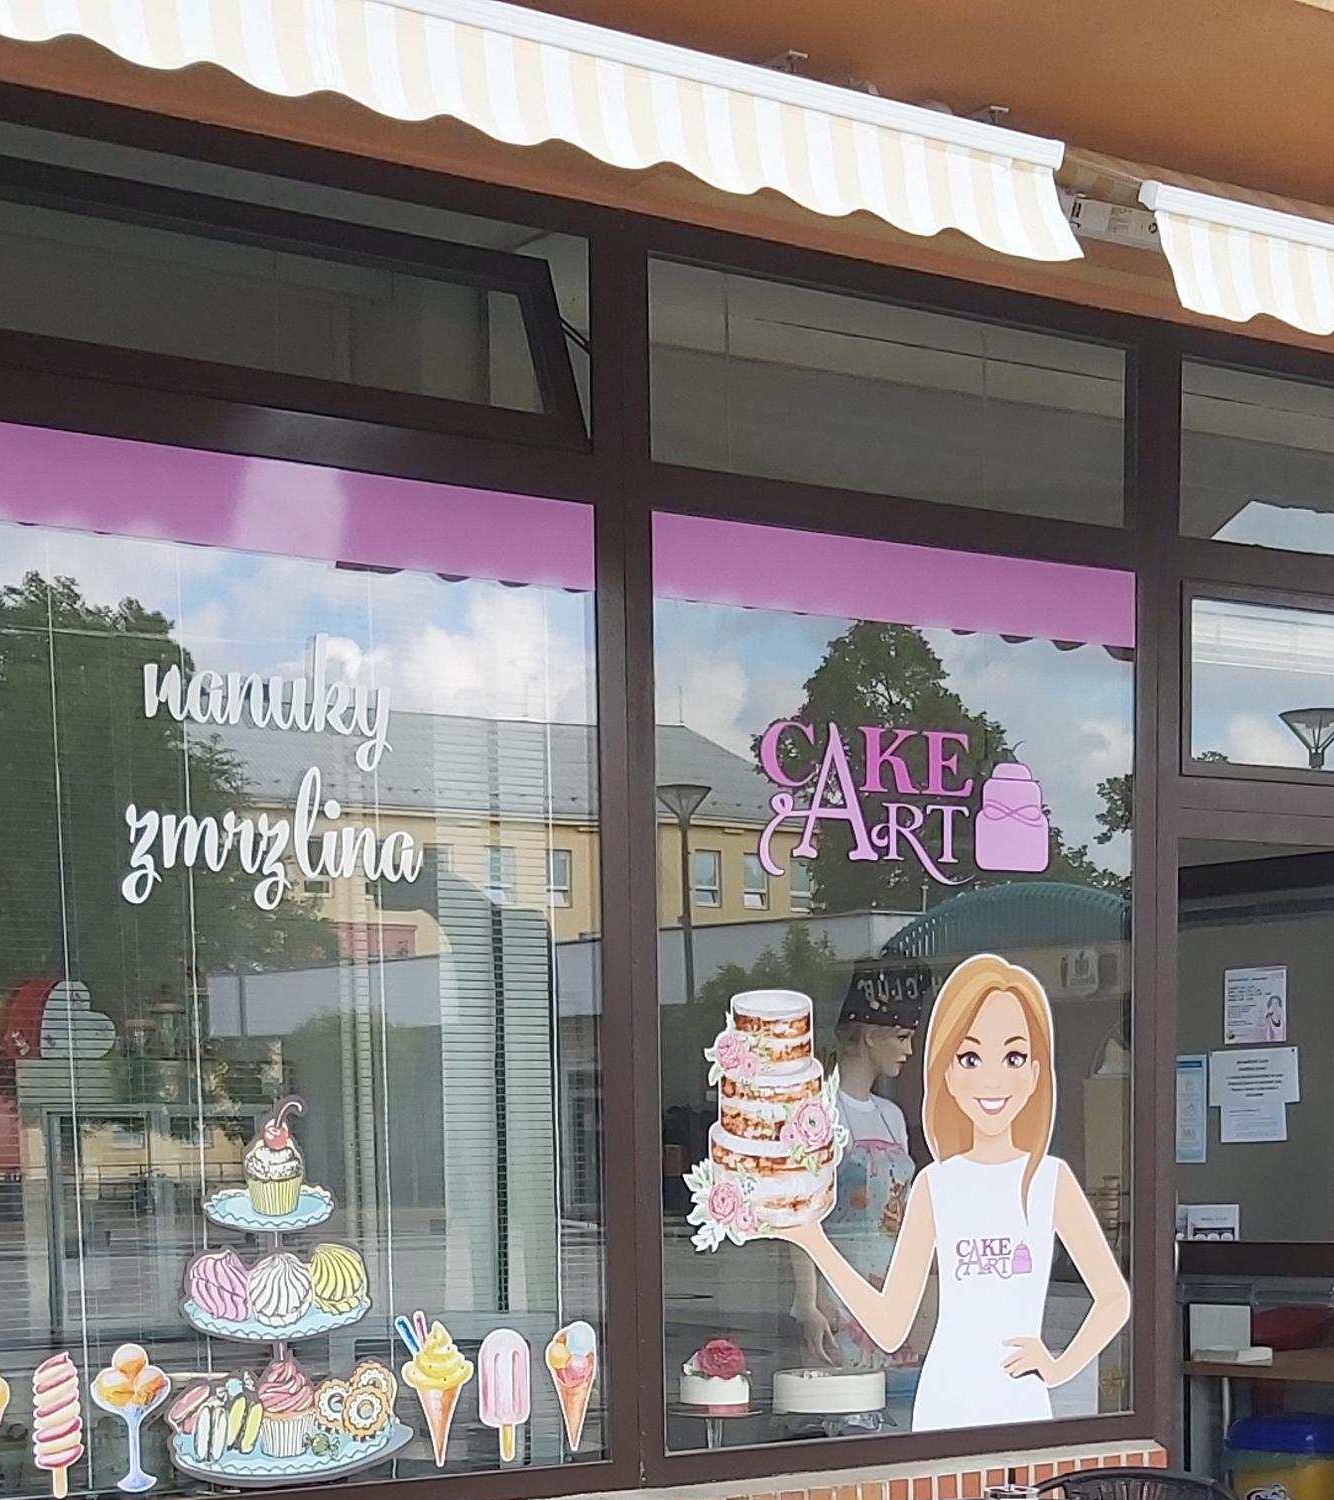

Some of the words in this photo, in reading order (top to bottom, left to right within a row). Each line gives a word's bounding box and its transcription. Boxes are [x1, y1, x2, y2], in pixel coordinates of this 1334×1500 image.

[143, 633, 392, 771] nanuky
[759, 720, 974, 799] CAKE
[122, 766, 424, 910] zmrzlina
[758, 772, 976, 885] ART
[955, 1238, 1012, 1258] CAKE
